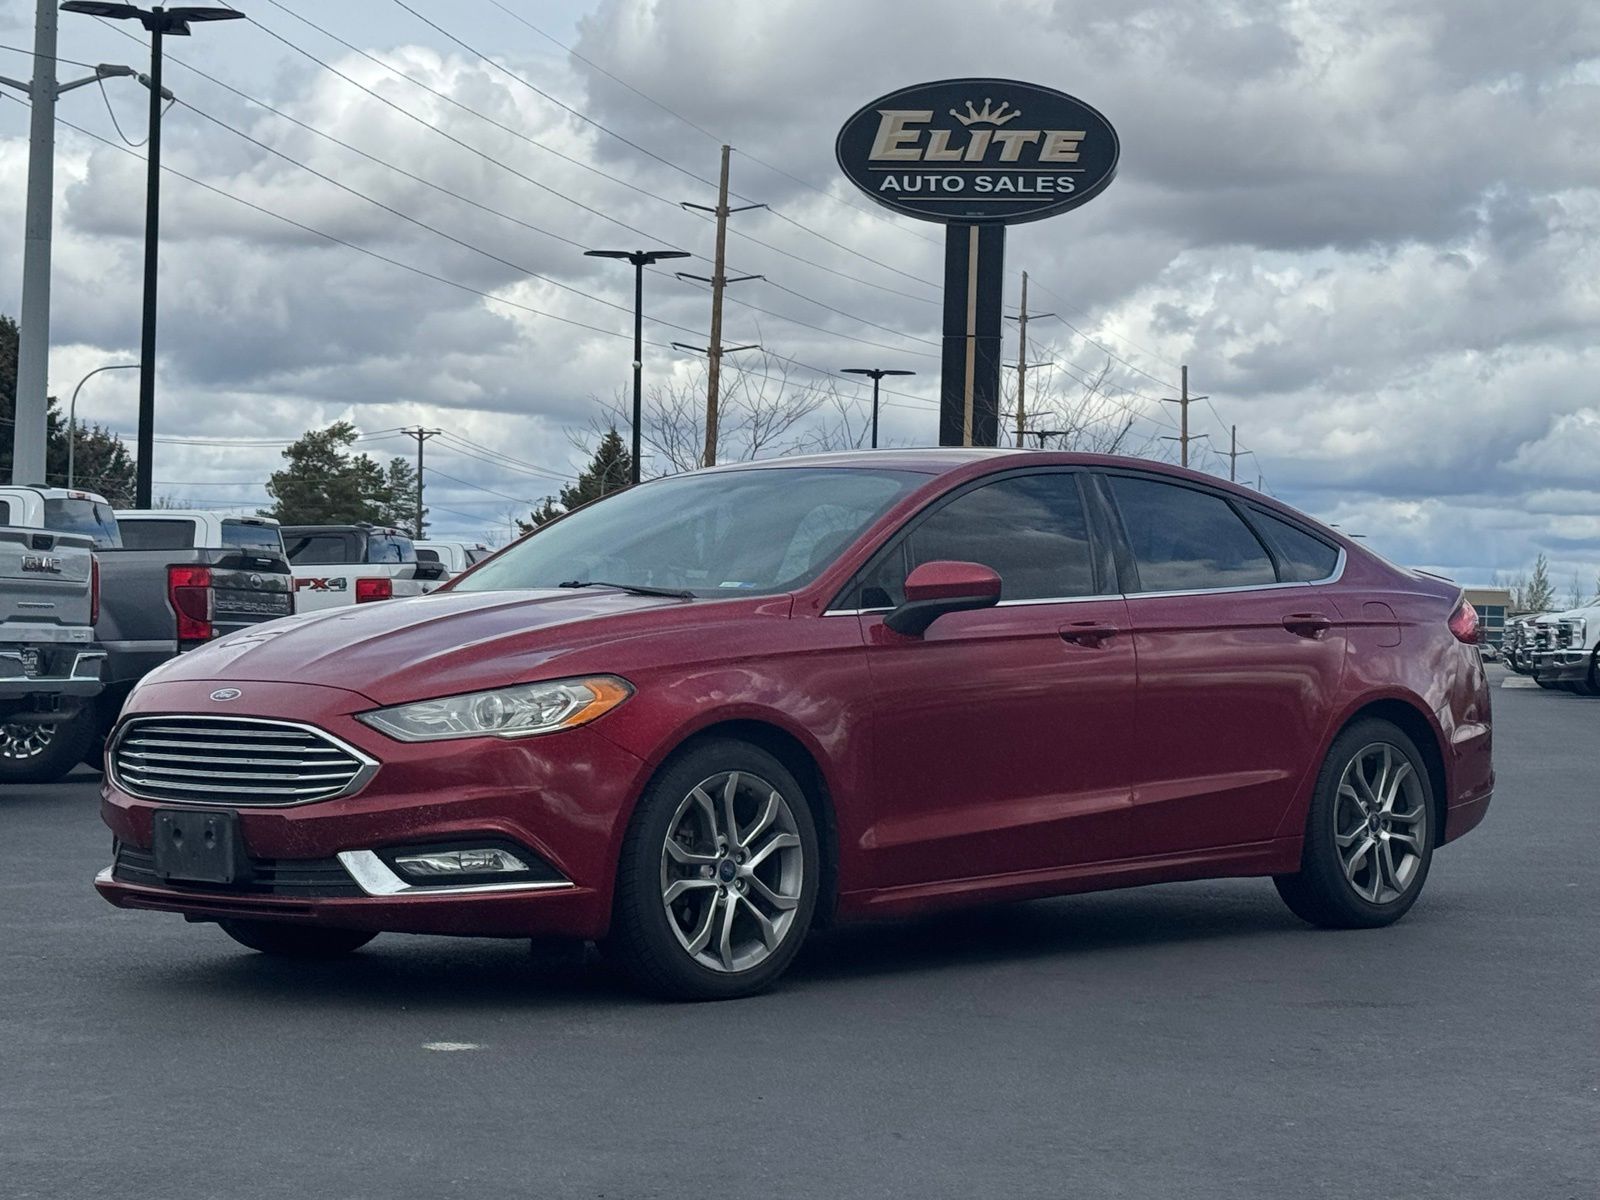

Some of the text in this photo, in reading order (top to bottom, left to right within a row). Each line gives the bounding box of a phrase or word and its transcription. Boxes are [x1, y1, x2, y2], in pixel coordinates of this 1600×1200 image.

[868, 110, 1087, 163] ELITE
[879, 175, 1076, 193] AUTO SALES
[21, 556, 61, 573] GMC
[294, 577, 347, 592] FX4
